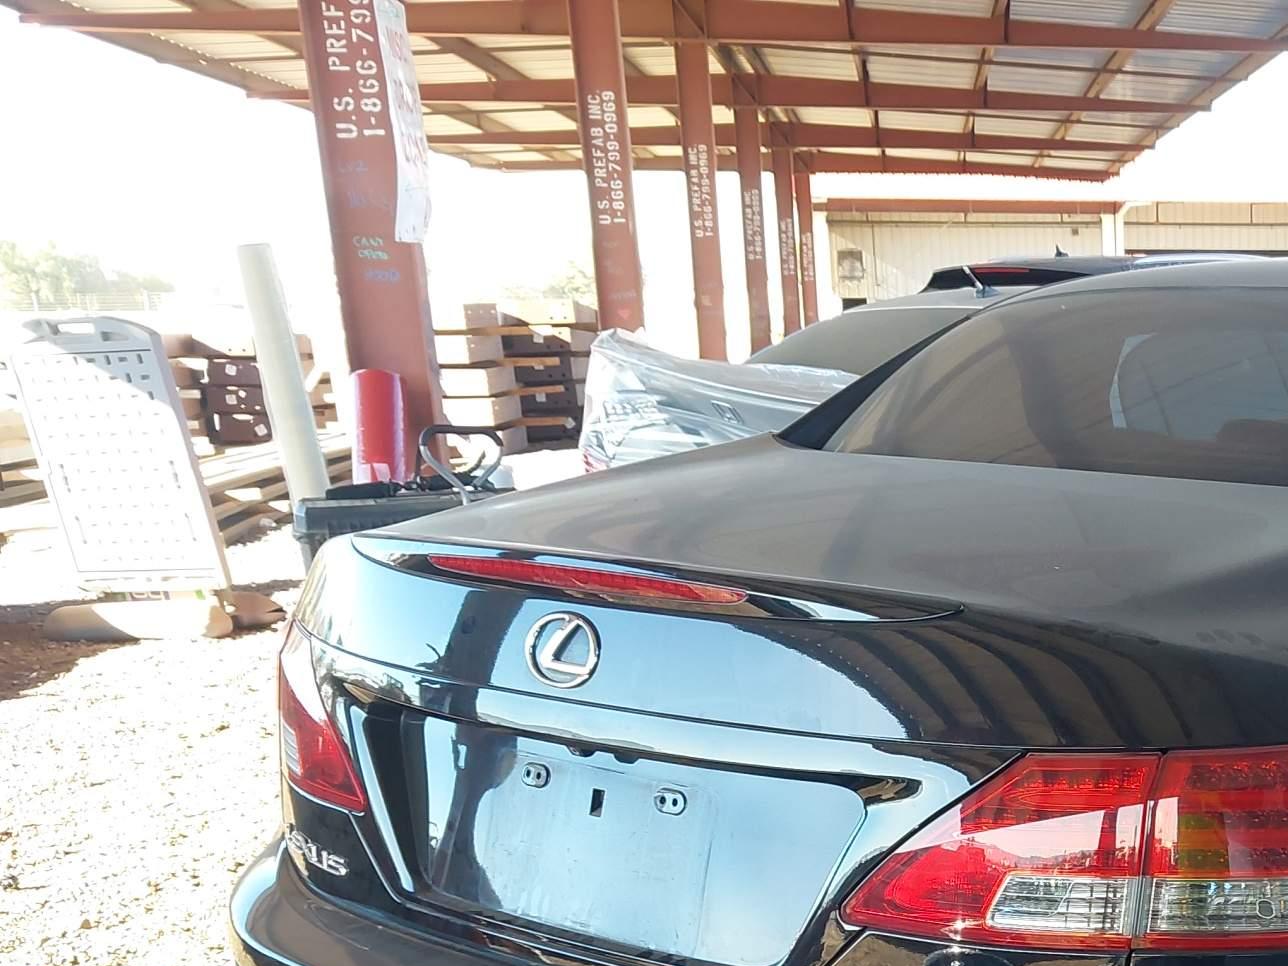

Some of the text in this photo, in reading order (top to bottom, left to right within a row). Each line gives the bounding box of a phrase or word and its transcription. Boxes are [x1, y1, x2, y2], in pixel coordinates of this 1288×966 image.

[348, 0, 386, 136] 1-866-79
[334, 87, 359, 138] U.S.
[590, 127, 609, 188] PREFAB
[601, 90, 627, 224] 1-866-799-0969
[597, 194, 612, 225] U.S.
